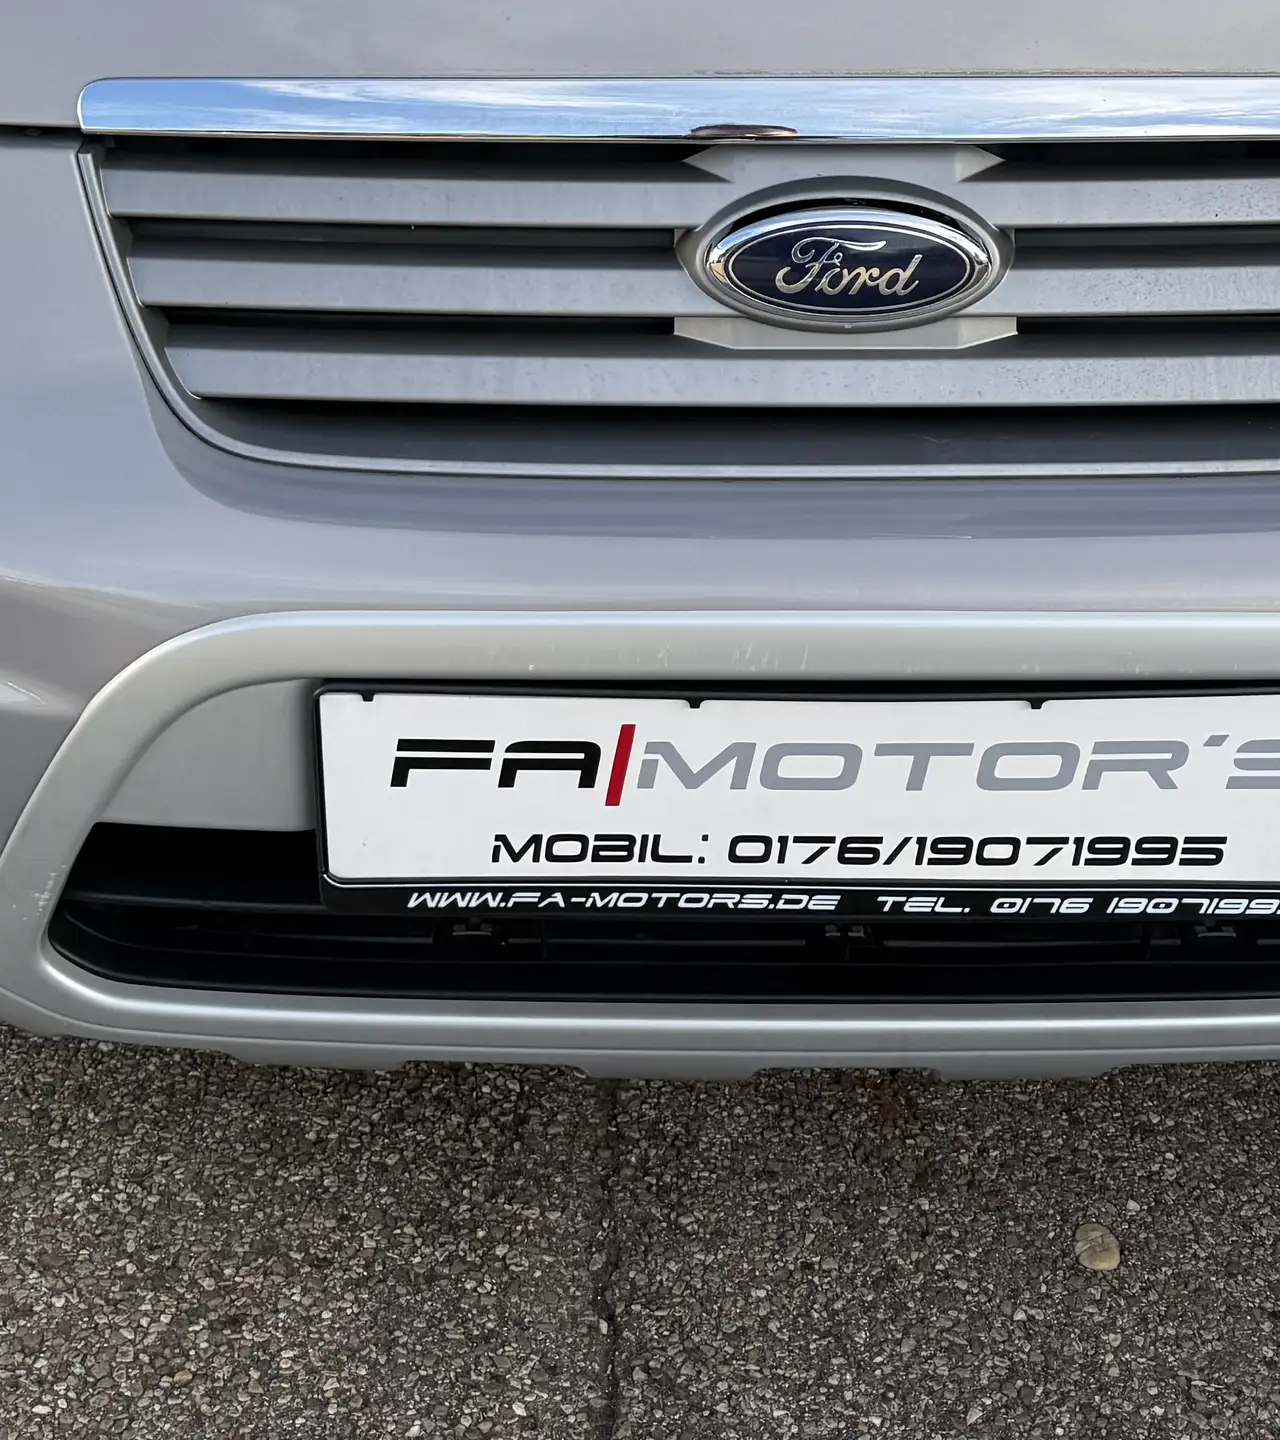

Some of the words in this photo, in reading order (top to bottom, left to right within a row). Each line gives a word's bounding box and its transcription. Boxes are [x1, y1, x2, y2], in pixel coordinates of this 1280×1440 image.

[774, 236, 924, 297] Ford
[491, 833, 710, 865] MOBIL:
[726, 834, 1228, 867] 0176/19071995
[406, 891, 842, 912] WWW.FA-MOTORS.DE
[876, 896, 972, 914] TEL.
[989, 897, 1094, 915] 0176
